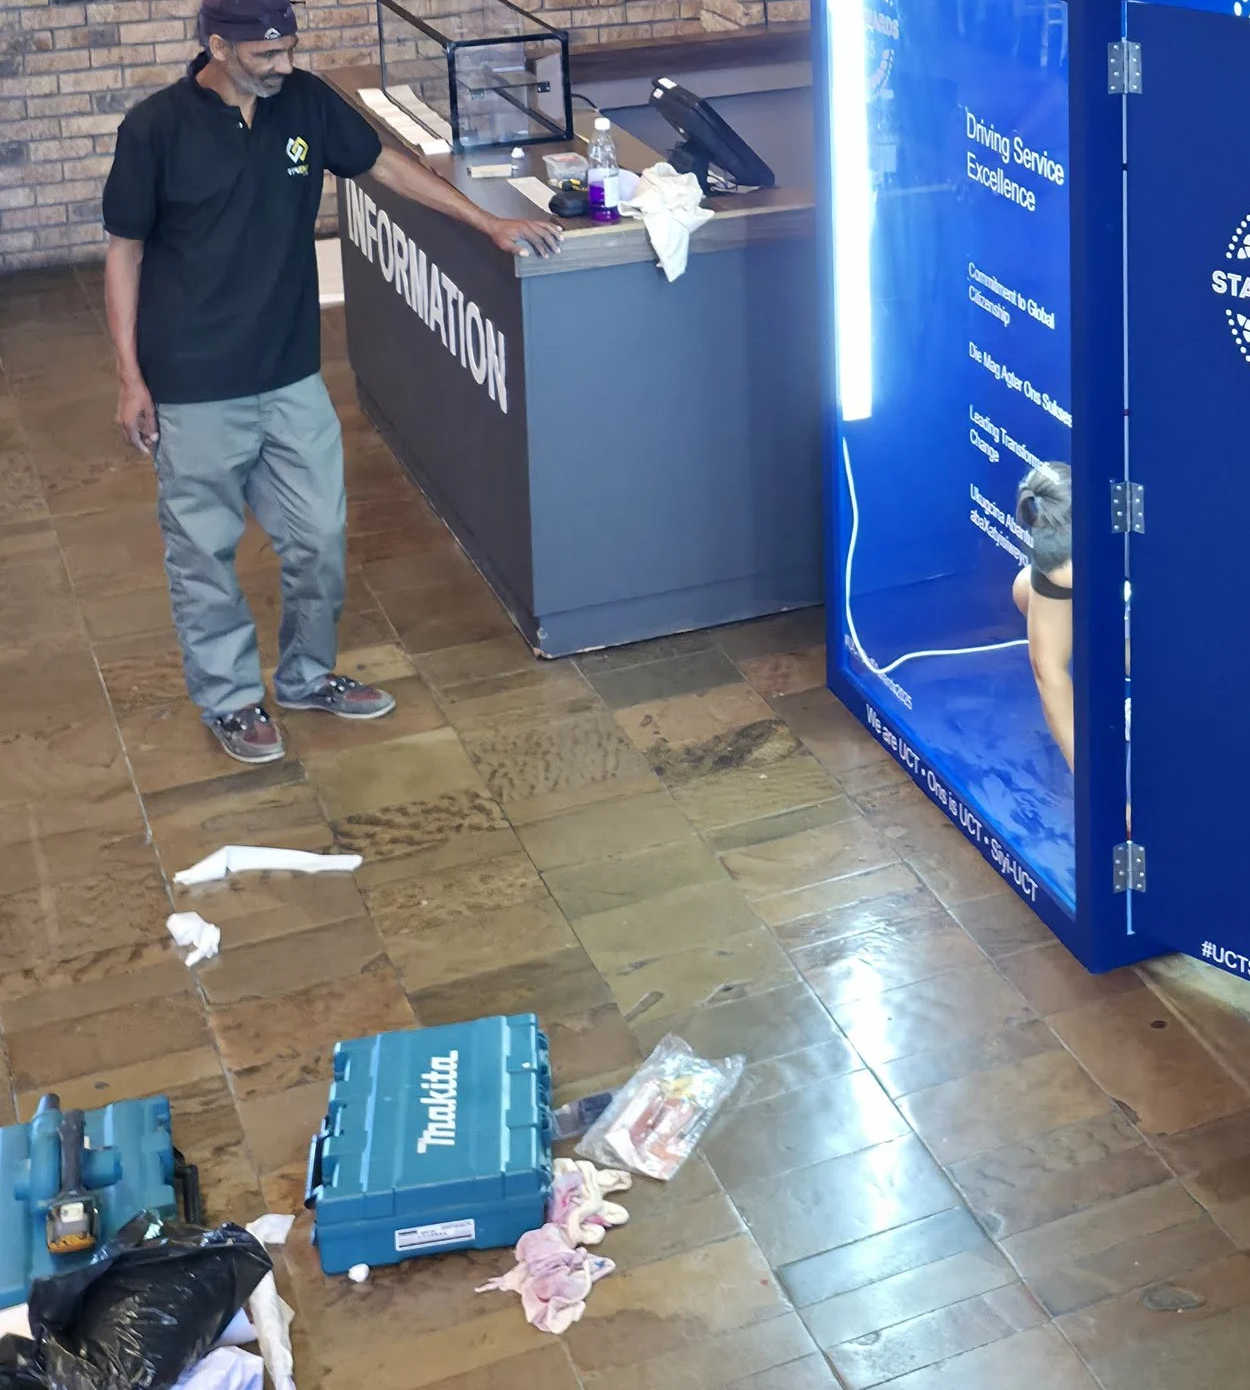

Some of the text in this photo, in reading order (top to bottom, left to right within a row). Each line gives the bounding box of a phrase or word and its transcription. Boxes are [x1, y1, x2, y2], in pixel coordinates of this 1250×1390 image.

[966, 111, 1065, 186] Driving Service
[966, 151, 1036, 212] Excellence
[345, 177, 508, 415] INFORMATION
[968, 261, 1056, 330] Commitment to Global
[968, 284, 1011, 328] Citizenship
[969, 341, 983, 363] Die
[983, 351, 1001, 380] Mag
[1001, 364, 1024, 390] Agter
[1023, 380, 1042, 406] Ons
[969, 403, 1000, 444] Leading
[969, 428, 1000, 463] Change
[865, 704, 1039, 902] We are UCT Ons is UCT Siyi-UCT
[417, 1050, 459, 1154] makita
